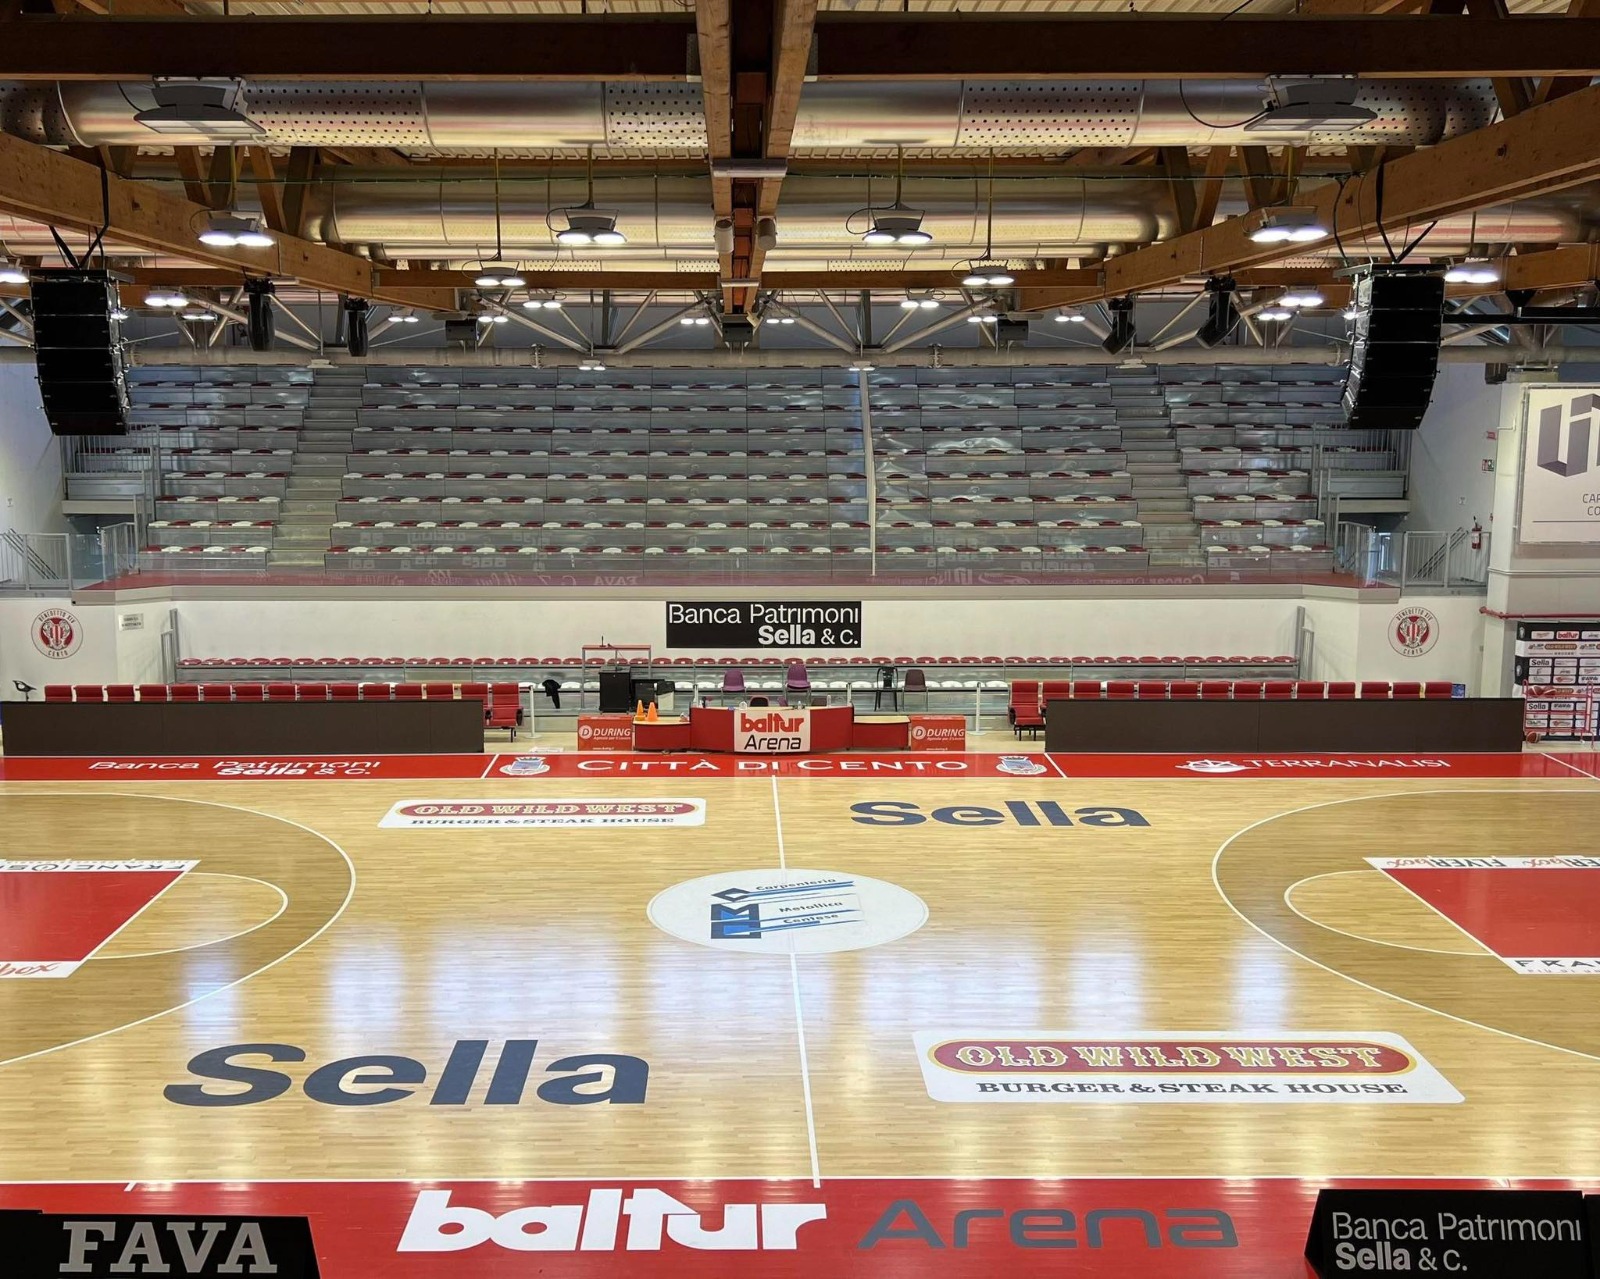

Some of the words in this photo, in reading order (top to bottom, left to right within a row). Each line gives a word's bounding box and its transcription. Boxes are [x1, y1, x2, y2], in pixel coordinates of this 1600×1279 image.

[668, 604, 742, 625] Banca
[750, 604, 859, 625] Patrimoni
[758, 624, 816, 645] Sella
[820, 628, 836, 645] &
[740, 712, 804, 733] baltur
[593, 728, 631, 737] DURING
[926, 728, 965, 737] DURING
[743, 734, 802, 751] Arena
[88, 761, 199, 770] Banca
[213, 761, 381, 770] Patrimoni
[577, 759, 720, 771] CITTÀ
[738, 761, 779, 770] DI
[797, 760, 968, 770] CENTO
[1242, 759, 1451, 768] TERRANALISI
[217, 767, 307, 776] Sella
[314, 768, 337, 776] &
[413, 805, 485, 815] OLD
[491, 804, 581, 815] WILD
[585, 804, 684, 814] WEST
[850, 800, 1152, 827] Sella
[756, 878, 837, 891] Carpenteria
[779, 901, 843, 913] Metallica
[783, 914, 839, 924] Centese
[956, 1046, 1068, 1067] OLD
[1072, 1046, 1221, 1067] WILD
[1221, 1046, 1381, 1067] WEST
[163, 1039, 650, 1106] Sella
[976, 1083, 1125, 1093] BURGER
[1129, 1083, 1156, 1093] &
[1160, 1083, 1278, 1093] STEAK
[1284, 1083, 1408, 1093] HOUSE
[397, 1188, 827, 1251] baltur
[857, 1199, 1240, 1249] Arena
[1332, 1211, 1428, 1240] Banca
[1438, 1212, 1581, 1241] Patrimoni
[59, 1221, 278, 1274] FAVA
[1335, 1241, 1411, 1271] Sella
[1418, 1247, 1438, 1271] &
